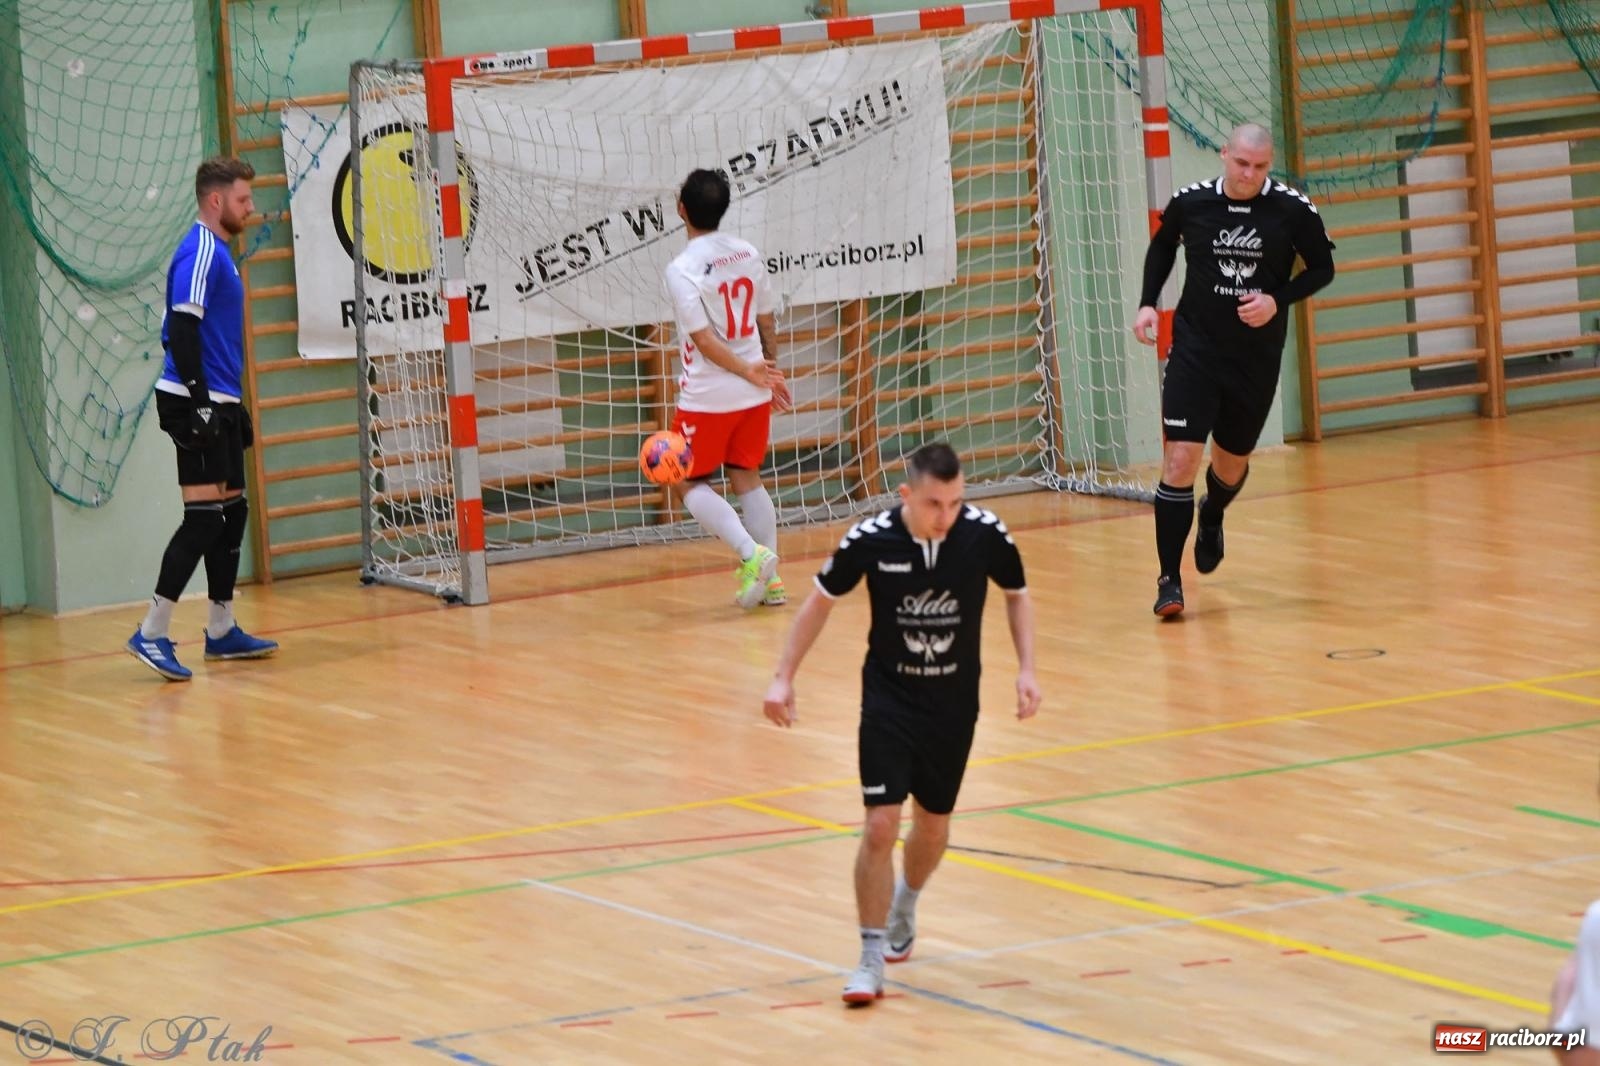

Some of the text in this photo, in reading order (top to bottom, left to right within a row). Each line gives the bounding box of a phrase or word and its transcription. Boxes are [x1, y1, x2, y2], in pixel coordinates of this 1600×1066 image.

[503, 55, 533, 69] sport
[515, 217, 611, 294] JEST
[622, 203, 665, 242] W
[761, 234, 924, 275] sir-raciborz.pl
[1212, 225, 1263, 250] Ada
[717, 276, 755, 341] 12
[896, 589, 960, 616] Ada
